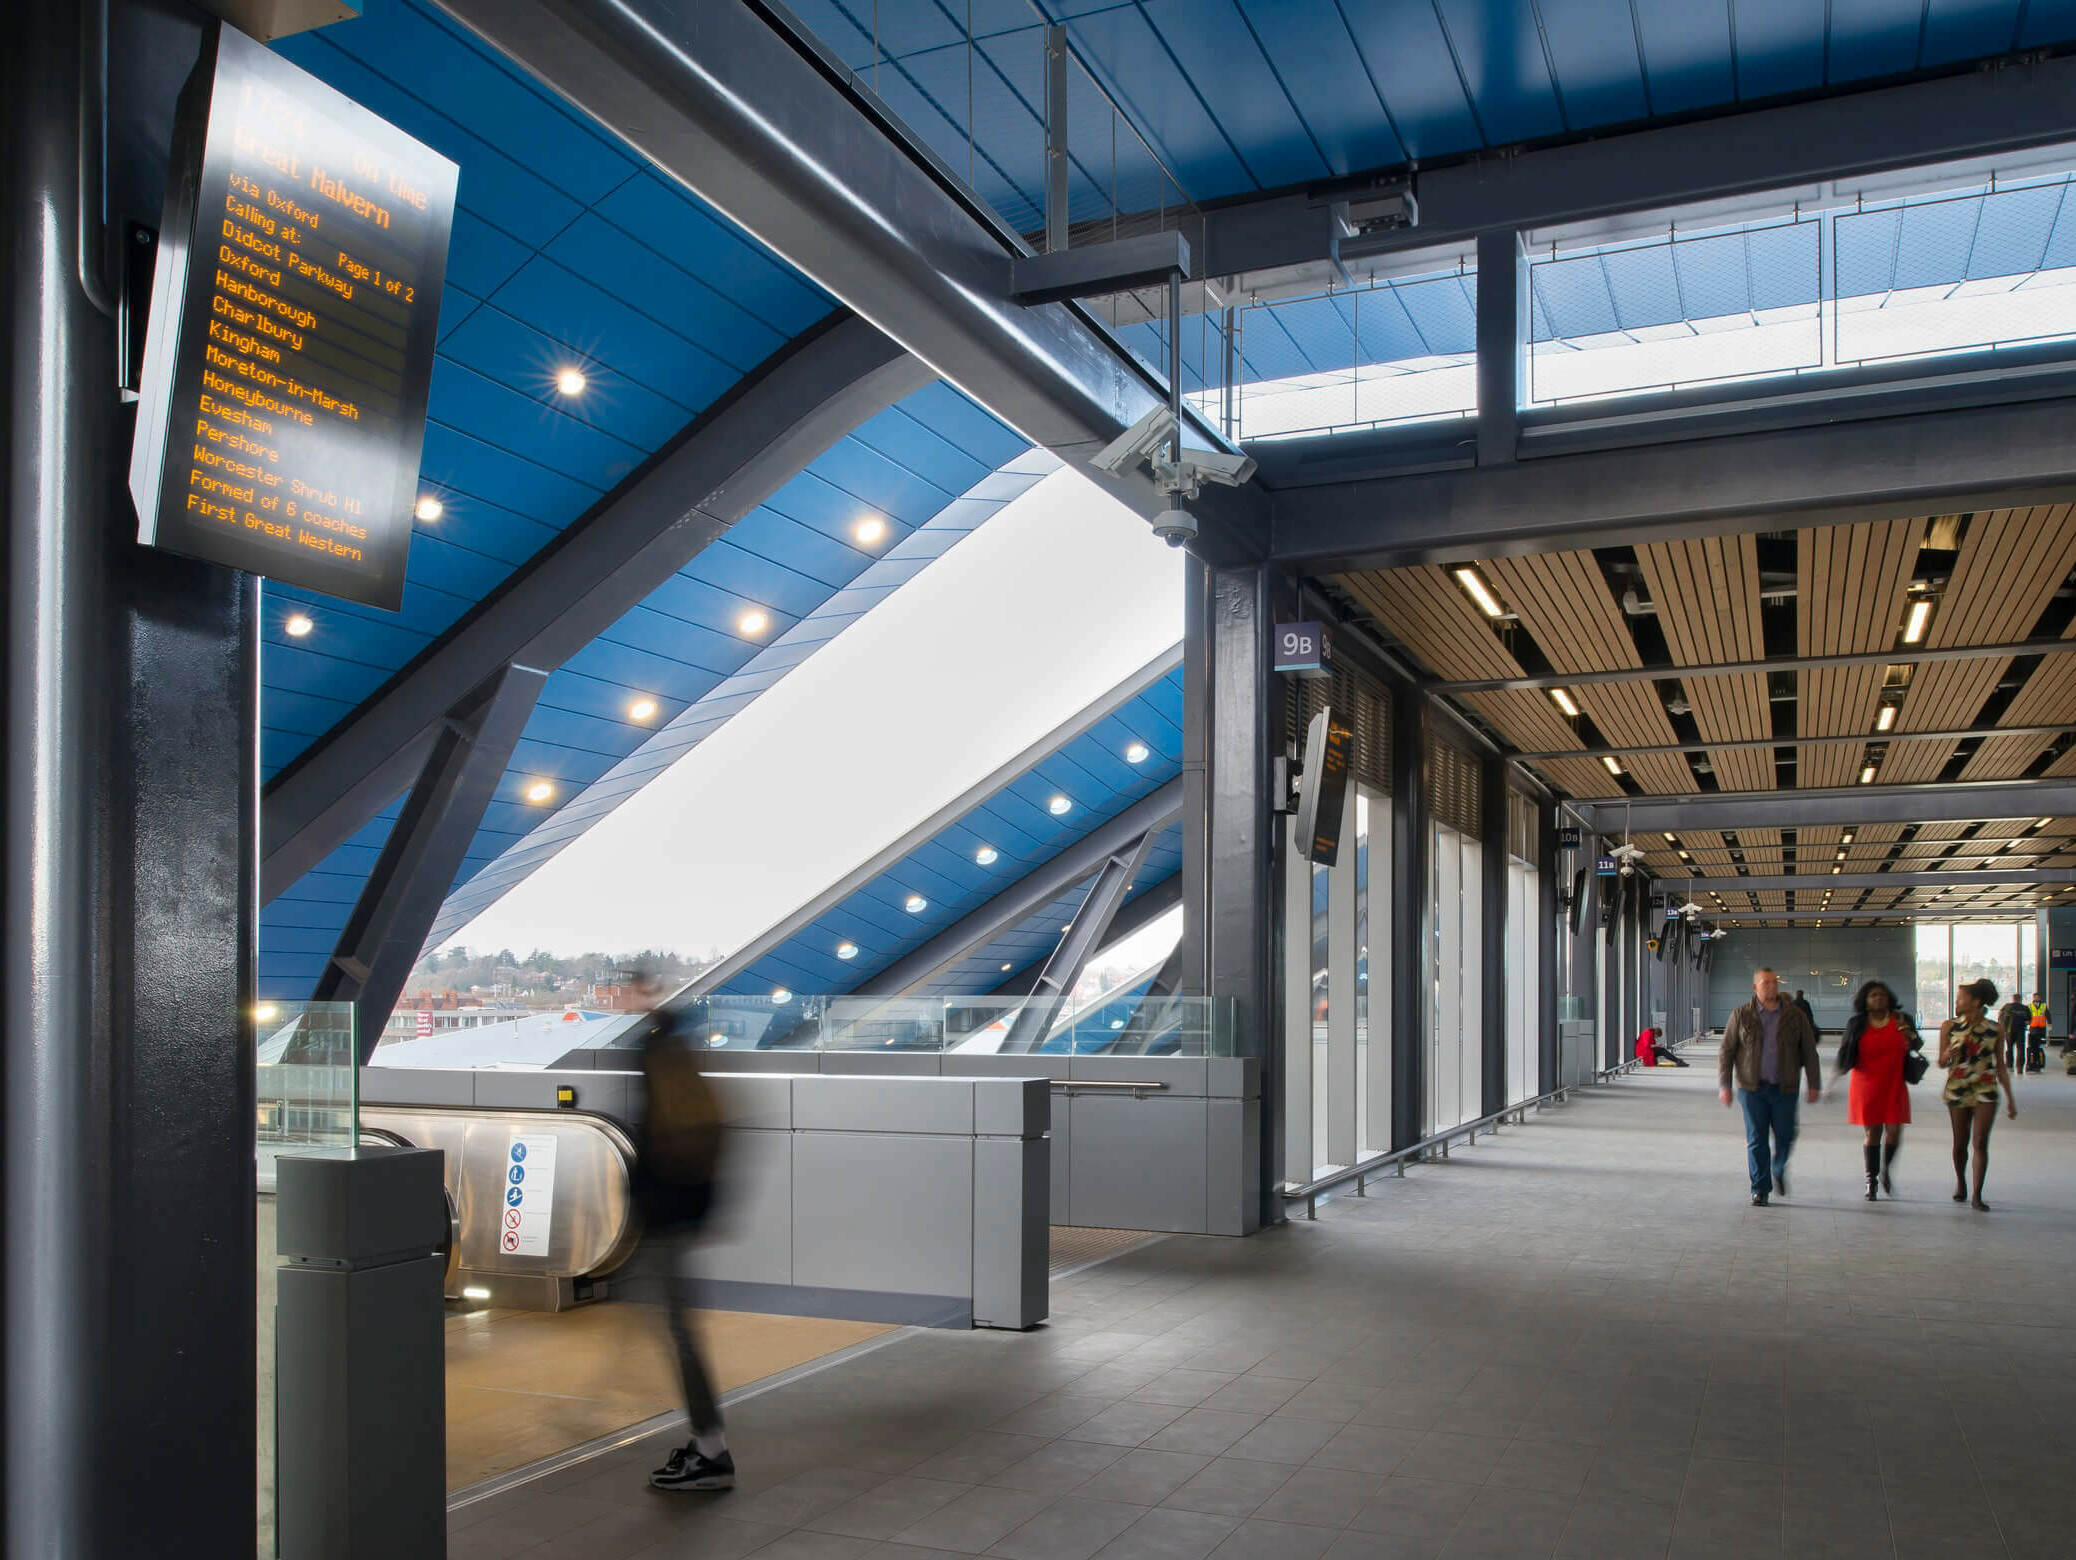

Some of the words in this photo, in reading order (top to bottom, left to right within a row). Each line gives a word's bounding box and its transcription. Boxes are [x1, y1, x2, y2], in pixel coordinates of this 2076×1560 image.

[229, 171, 260, 199] via
[267, 189, 319, 230] Oxford
[311, 165, 390, 230] Malvern
[219, 245, 281, 287] Oxford
[222, 219, 281, 262] Didcot
[288, 252, 353, 300] Parkway
[226, 194, 276, 236] Calling
[281, 225, 301, 244] at:
[338, 251, 370, 281] Page
[374, 271, 381, 287] 1
[386, 279, 402, 295] of
[405, 287, 415, 303] 2
[213, 295, 302, 351] Charlbury
[215, 269, 317, 329] Hanborough
[209, 319, 280, 364] Kingham
[203, 369, 314, 426] Honeybourne
[206, 344, 359, 420] Moreton-in-Marsh
[197, 419, 279, 463] Pershore
[200, 394, 272, 435] Evesham
[190, 469, 254, 503] Formed
[261, 496, 278, 511] of
[286, 501, 297, 517] 6
[303, 511, 367, 540] coaches
[193, 444, 283, 487] Worcester
[291, 479, 337, 508] Shrub
[187, 493, 237, 523] First
[245, 512, 292, 540] Great
[299, 528, 362, 561] Western
[1283, 632, 1312, 656] 9B
